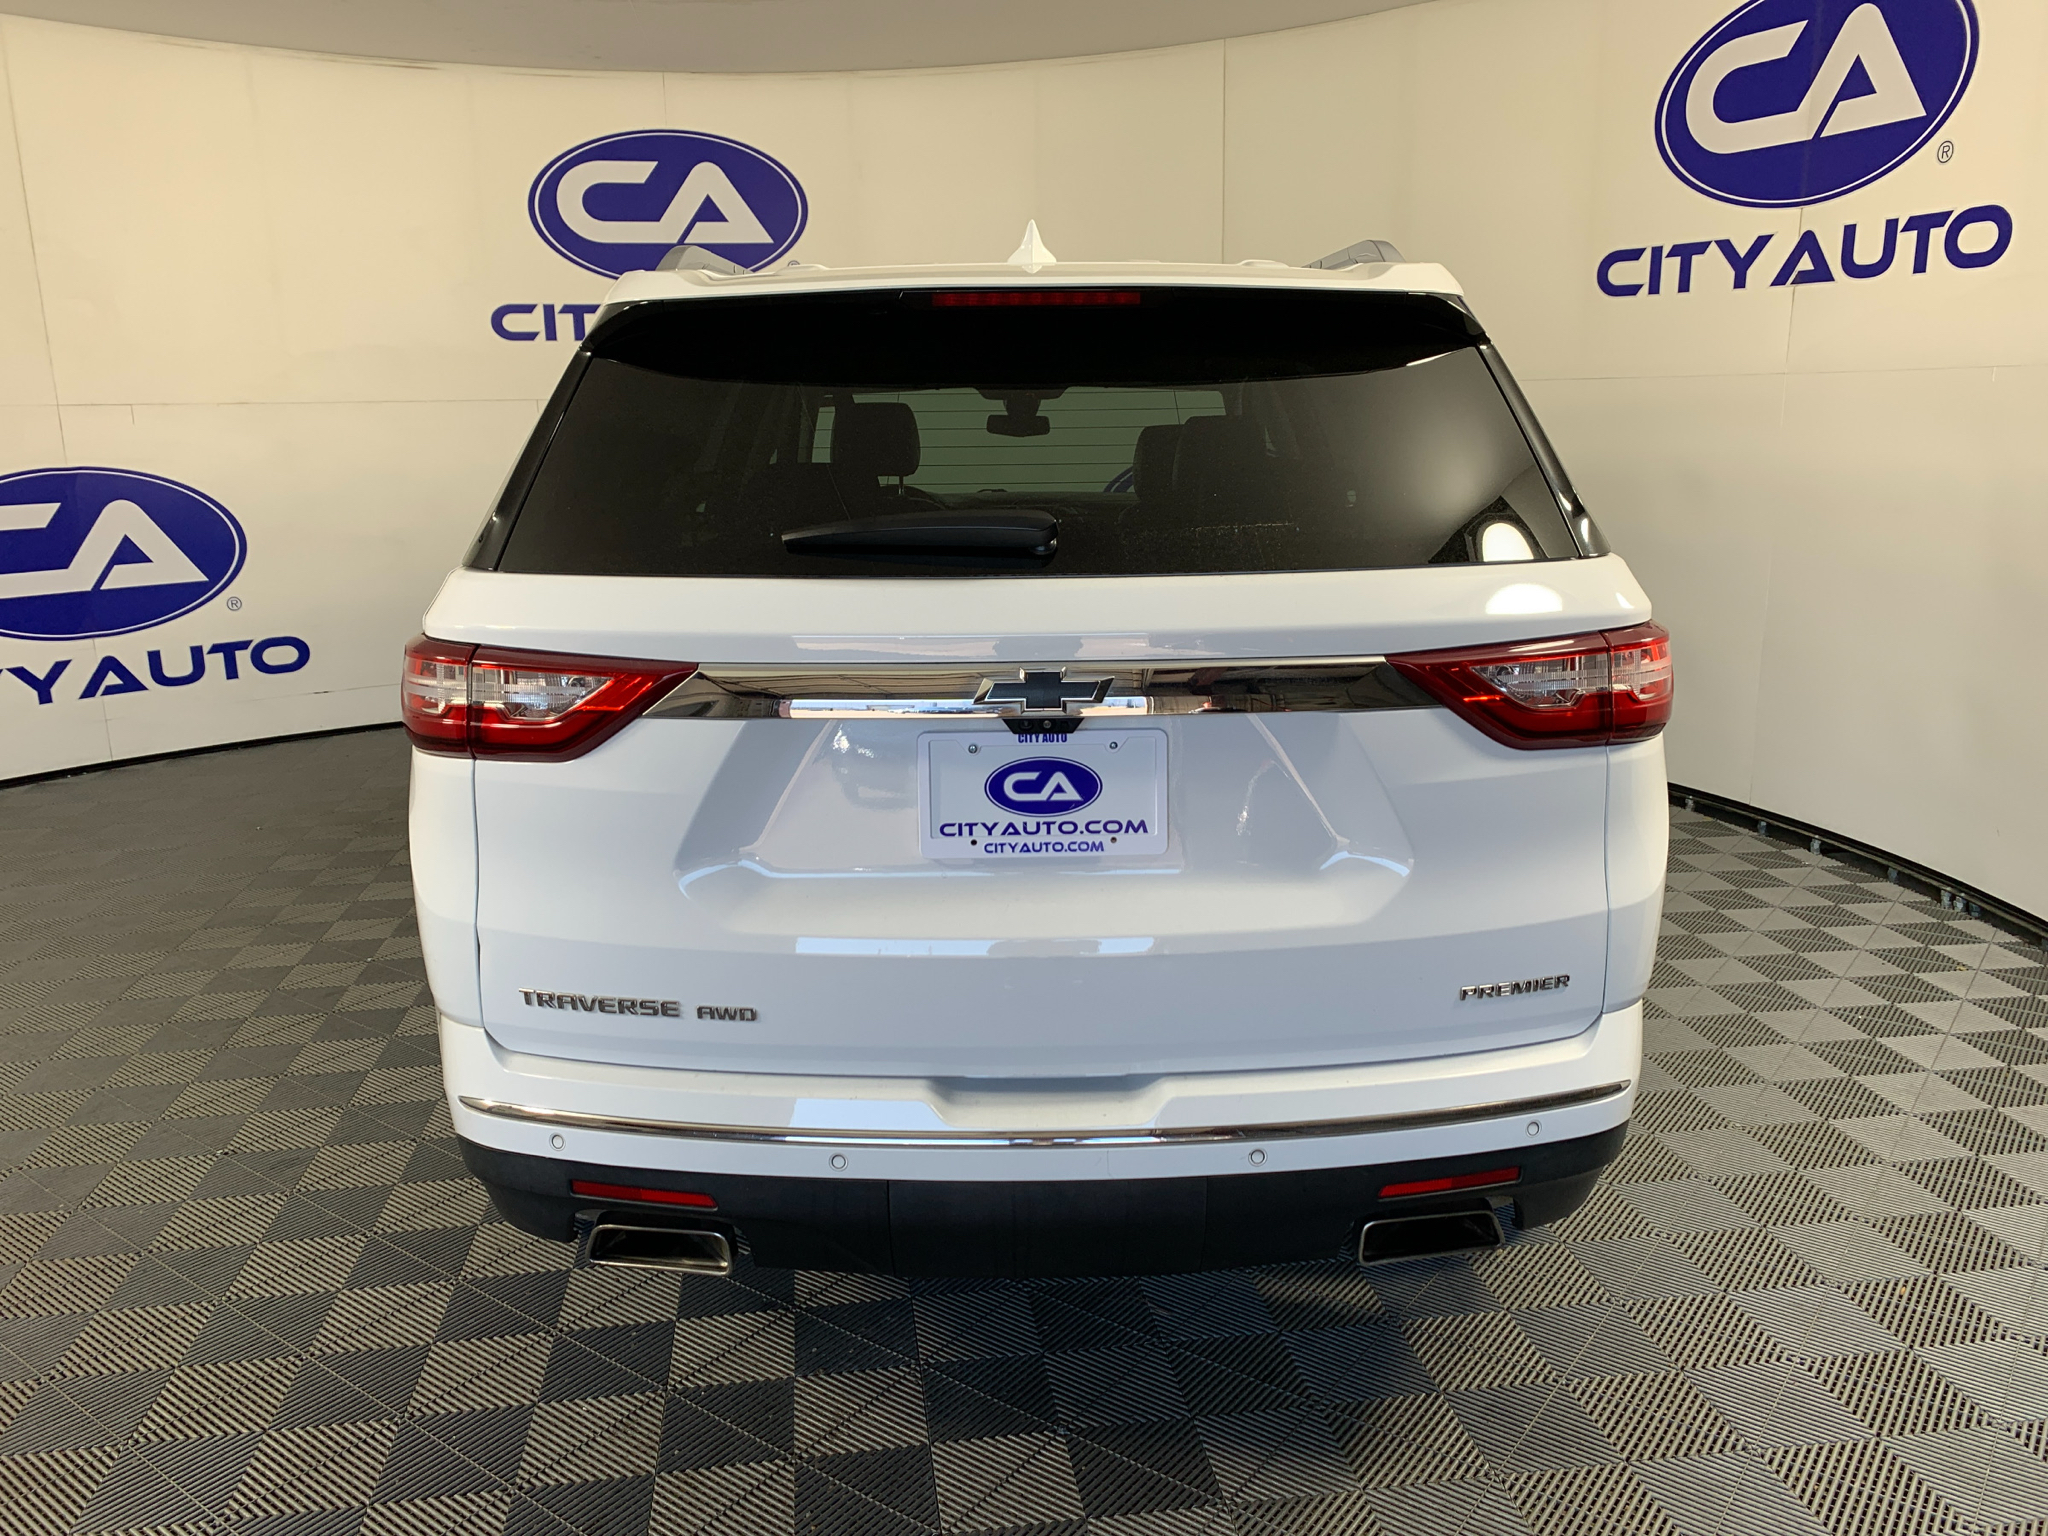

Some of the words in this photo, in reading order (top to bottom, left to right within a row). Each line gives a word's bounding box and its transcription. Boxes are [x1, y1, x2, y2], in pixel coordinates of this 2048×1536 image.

[1685, 3, 1927, 154] CA
[556, 160, 775, 244] CA
[1018, 733, 1040, 743] CITY
[1042, 733, 1067, 743] AUTO
[1003, 771, 1084, 802] CA
[939, 819, 1148, 837] CITYAUTO.COM
[984, 840, 1105, 854] CITYAUTO.COM
[1460, 974, 1570, 1001] PREMIER
[518, 987, 681, 1017] TRAVERSE
[696, 1005, 758, 1021] AWD
